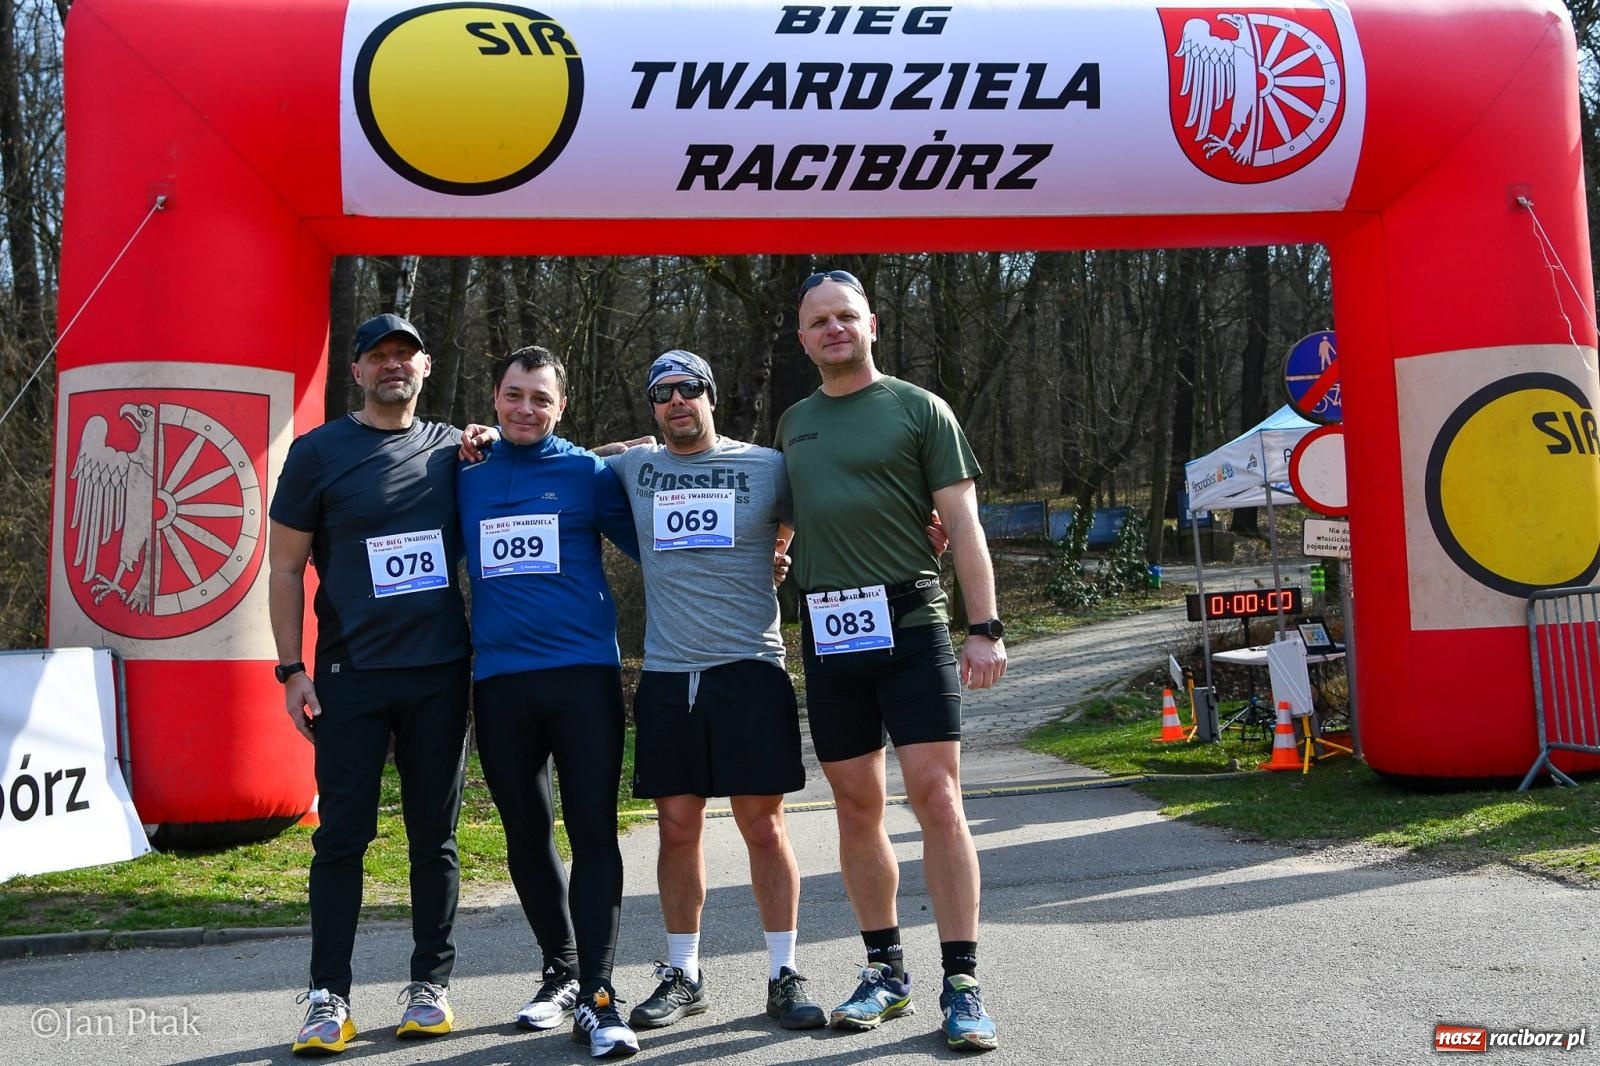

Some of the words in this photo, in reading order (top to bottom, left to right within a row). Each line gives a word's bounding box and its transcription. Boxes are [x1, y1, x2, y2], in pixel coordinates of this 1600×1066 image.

[774, 5, 953, 35] BIEG
[465, 22, 579, 55] SIR
[630, 61, 1100, 110] TWARDZIELA
[675, 129, 1055, 191] RACIBÓRZ
[637, 462, 750, 492] CrossFit
[636, 488, 654, 499] FORG
[671, 493, 686, 501] BIEG
[688, 492, 728, 500] TWARDZIELA
[497, 521, 511, 529] BIEG
[512, 519, 552, 527] TWARDZIELA
[667, 509, 718, 533] 069
[386, 538, 402, 546] BIEG
[404, 534, 438, 544] TWARDZIELA
[493, 536, 544, 560] 089
[1306, 543, 1337, 551] pojazdów
[1316, 535, 1349, 543] właściciel
[386, 551, 434, 578] 078
[1211, 591, 1292, 615] 0:00:00
[825, 610, 876, 637] 083
